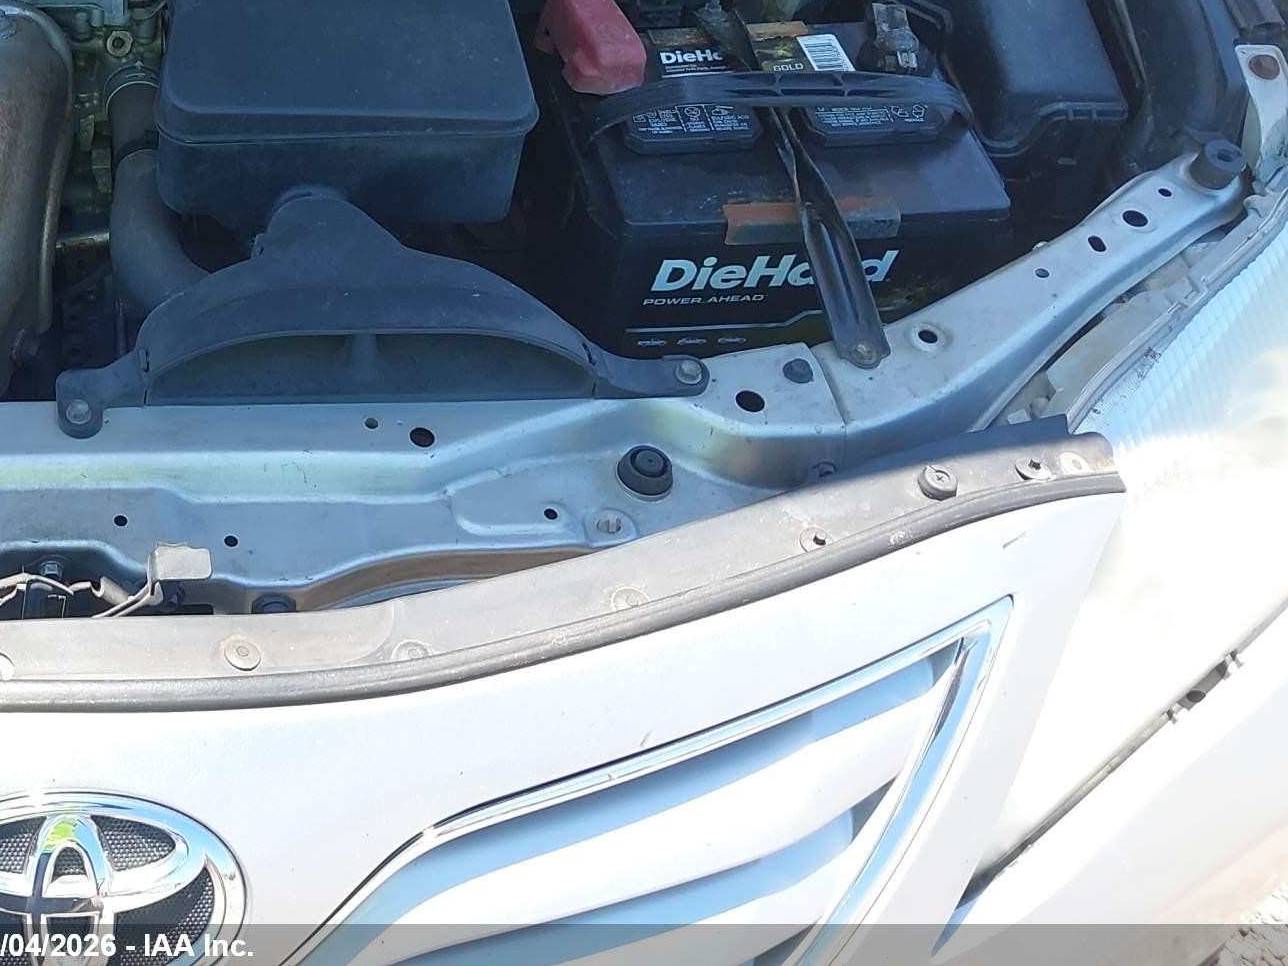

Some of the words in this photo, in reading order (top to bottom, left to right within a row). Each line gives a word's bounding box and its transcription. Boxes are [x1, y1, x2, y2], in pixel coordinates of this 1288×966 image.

[773, 62, 804, 71] GOLD
[650, 250, 900, 292] DieHad
[642, 296, 704, 306] POWER
[706, 294, 765, 304] AHEAD
